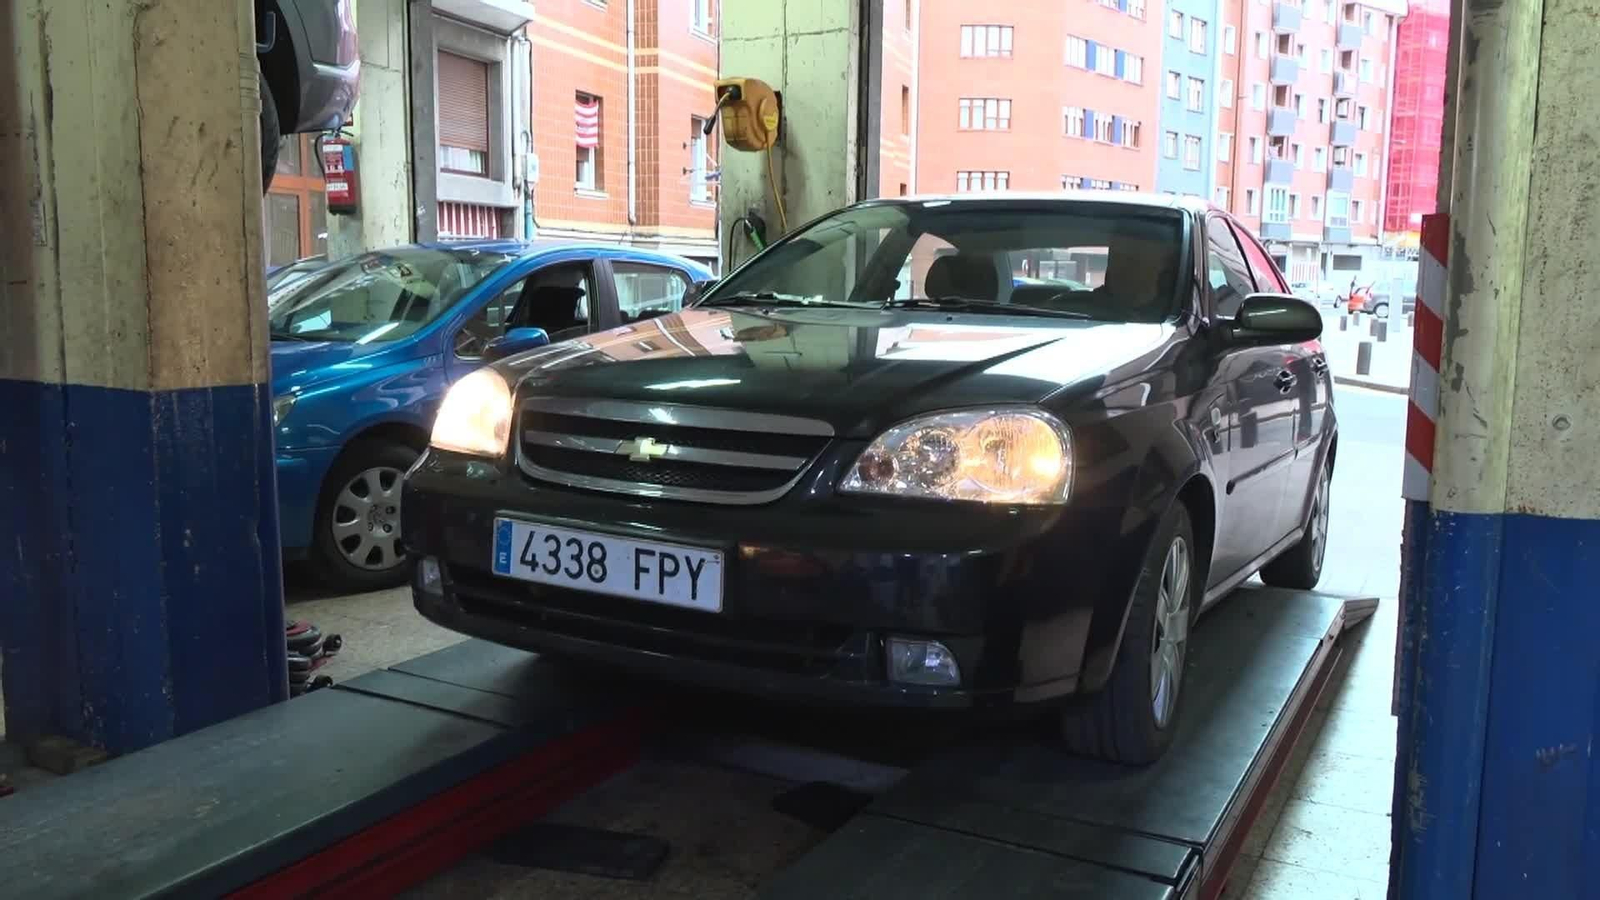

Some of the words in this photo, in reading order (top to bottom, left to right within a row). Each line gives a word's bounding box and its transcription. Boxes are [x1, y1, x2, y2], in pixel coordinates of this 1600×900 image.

[499, 551, 507, 564] E
[519, 530, 607, 583] 4338
[634, 547, 706, 601] FPY
